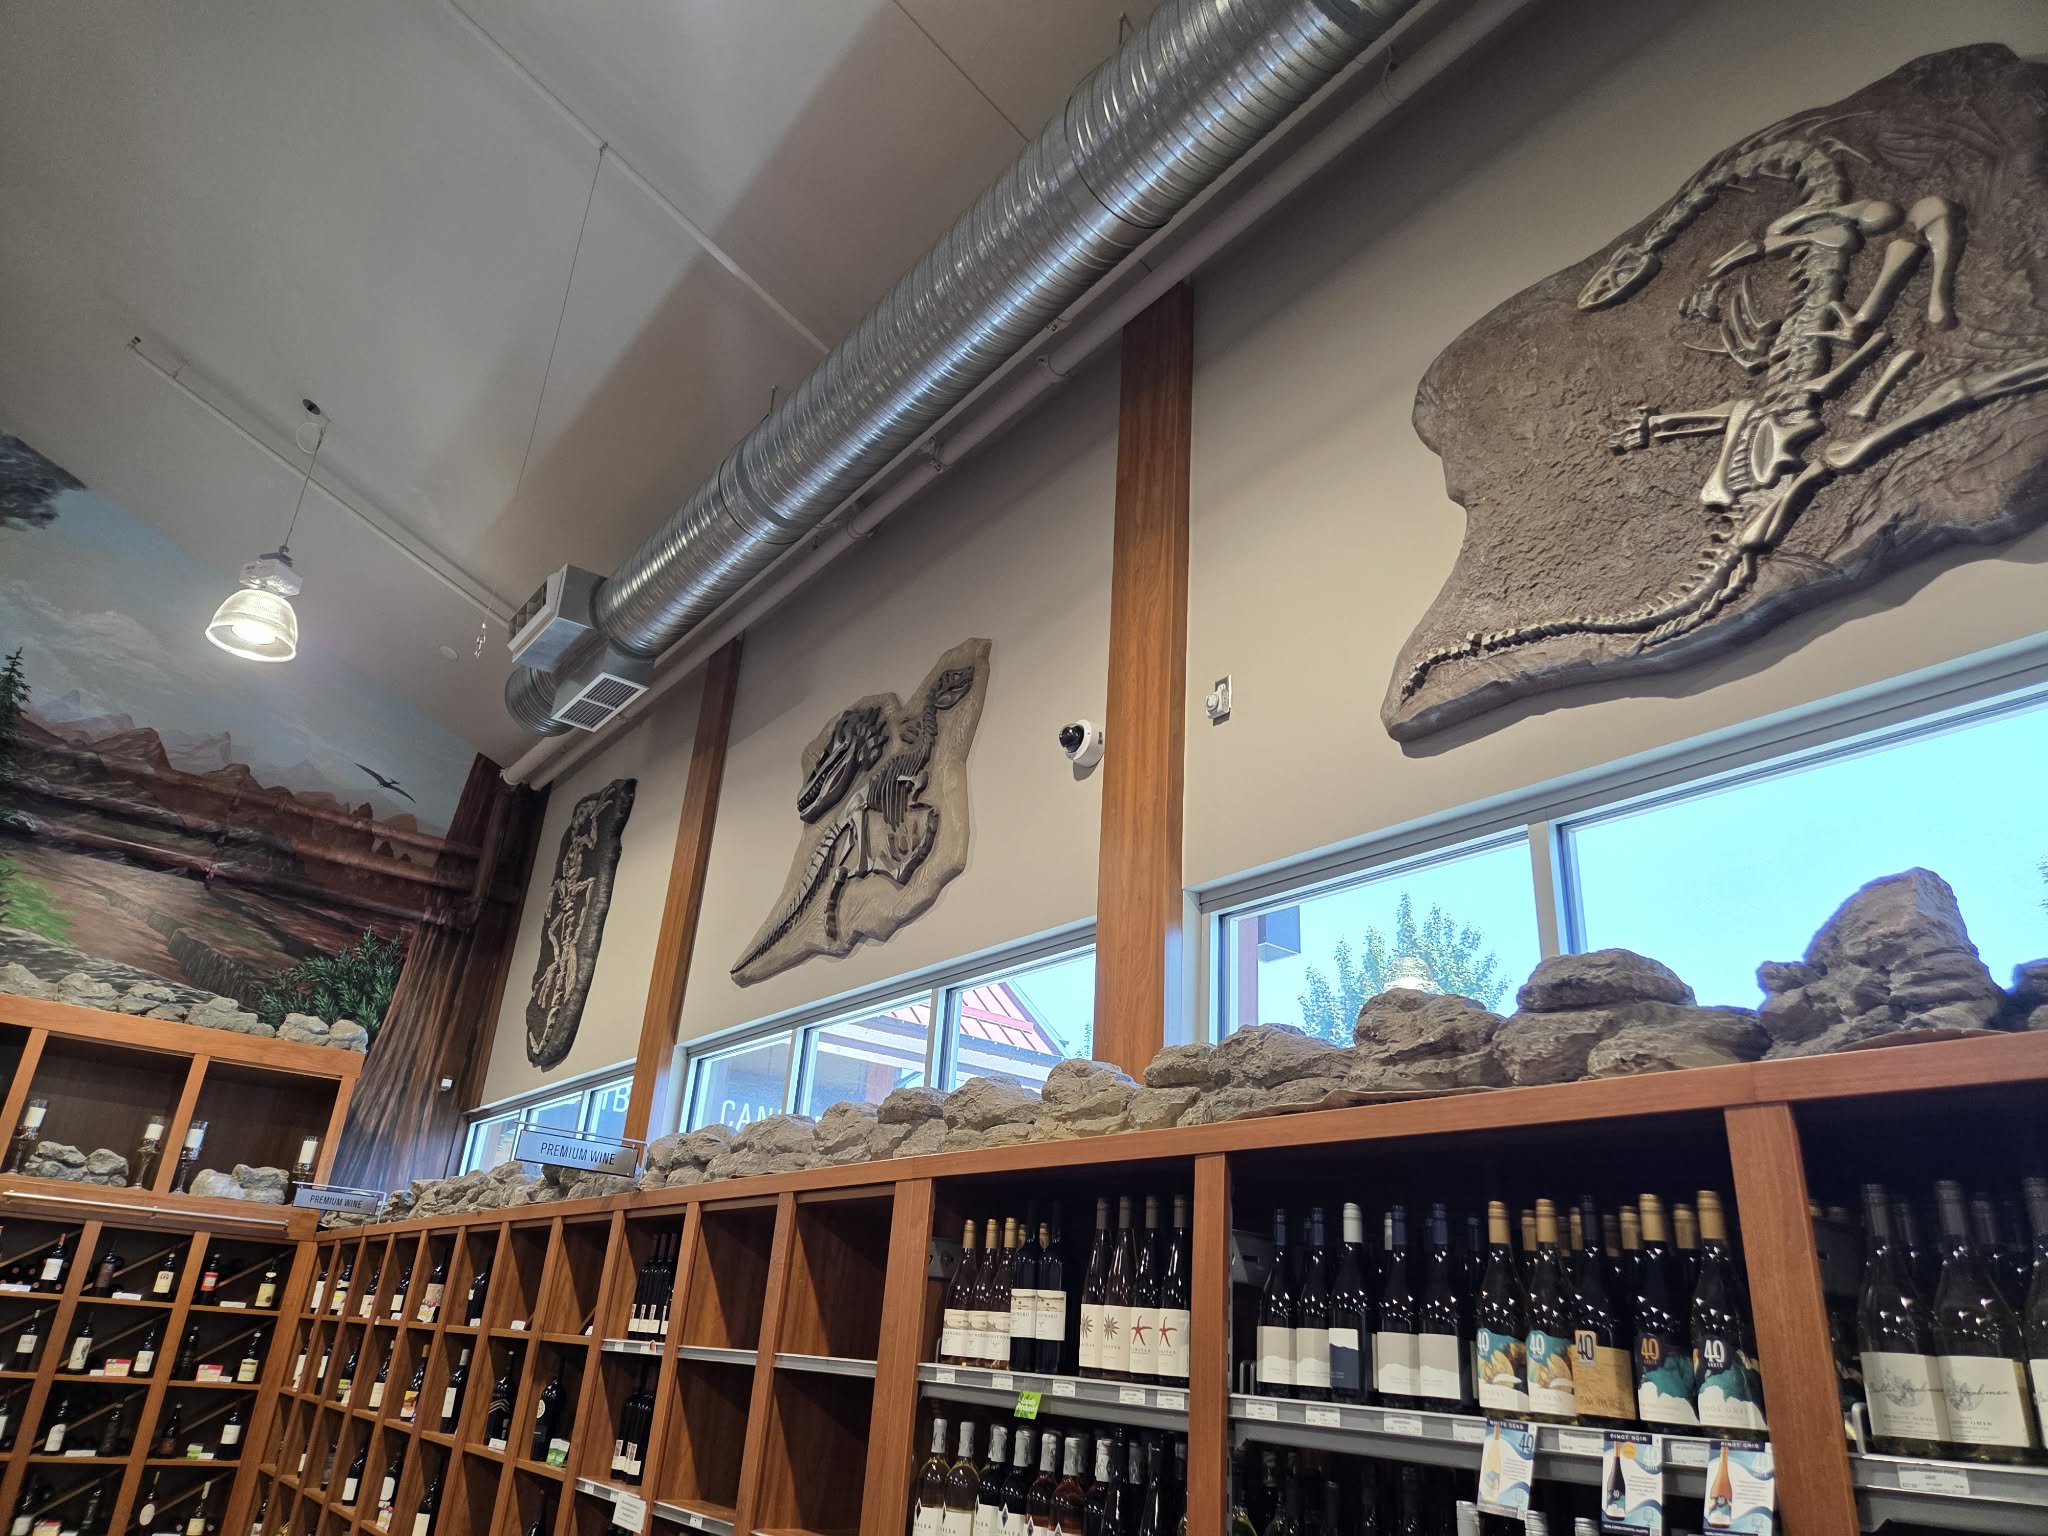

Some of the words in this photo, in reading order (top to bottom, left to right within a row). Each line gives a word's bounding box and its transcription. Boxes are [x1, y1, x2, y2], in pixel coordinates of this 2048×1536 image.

[540, 1142, 588, 1161] PREMIUM
[590, 1150, 616, 1165] WINE
[309, 1194, 342, 1206] PREMIUM
[344, 1199, 362, 1209] WINE
[1477, 1330, 1490, 1352] 40
[1529, 1333, 1545, 1355] 40
[1577, 1334, 1595, 1361] 40
[1641, 1337, 1659, 1361] 40
[1704, 1339, 1725, 1363] 40
[1519, 1433, 1534, 1452] 40
